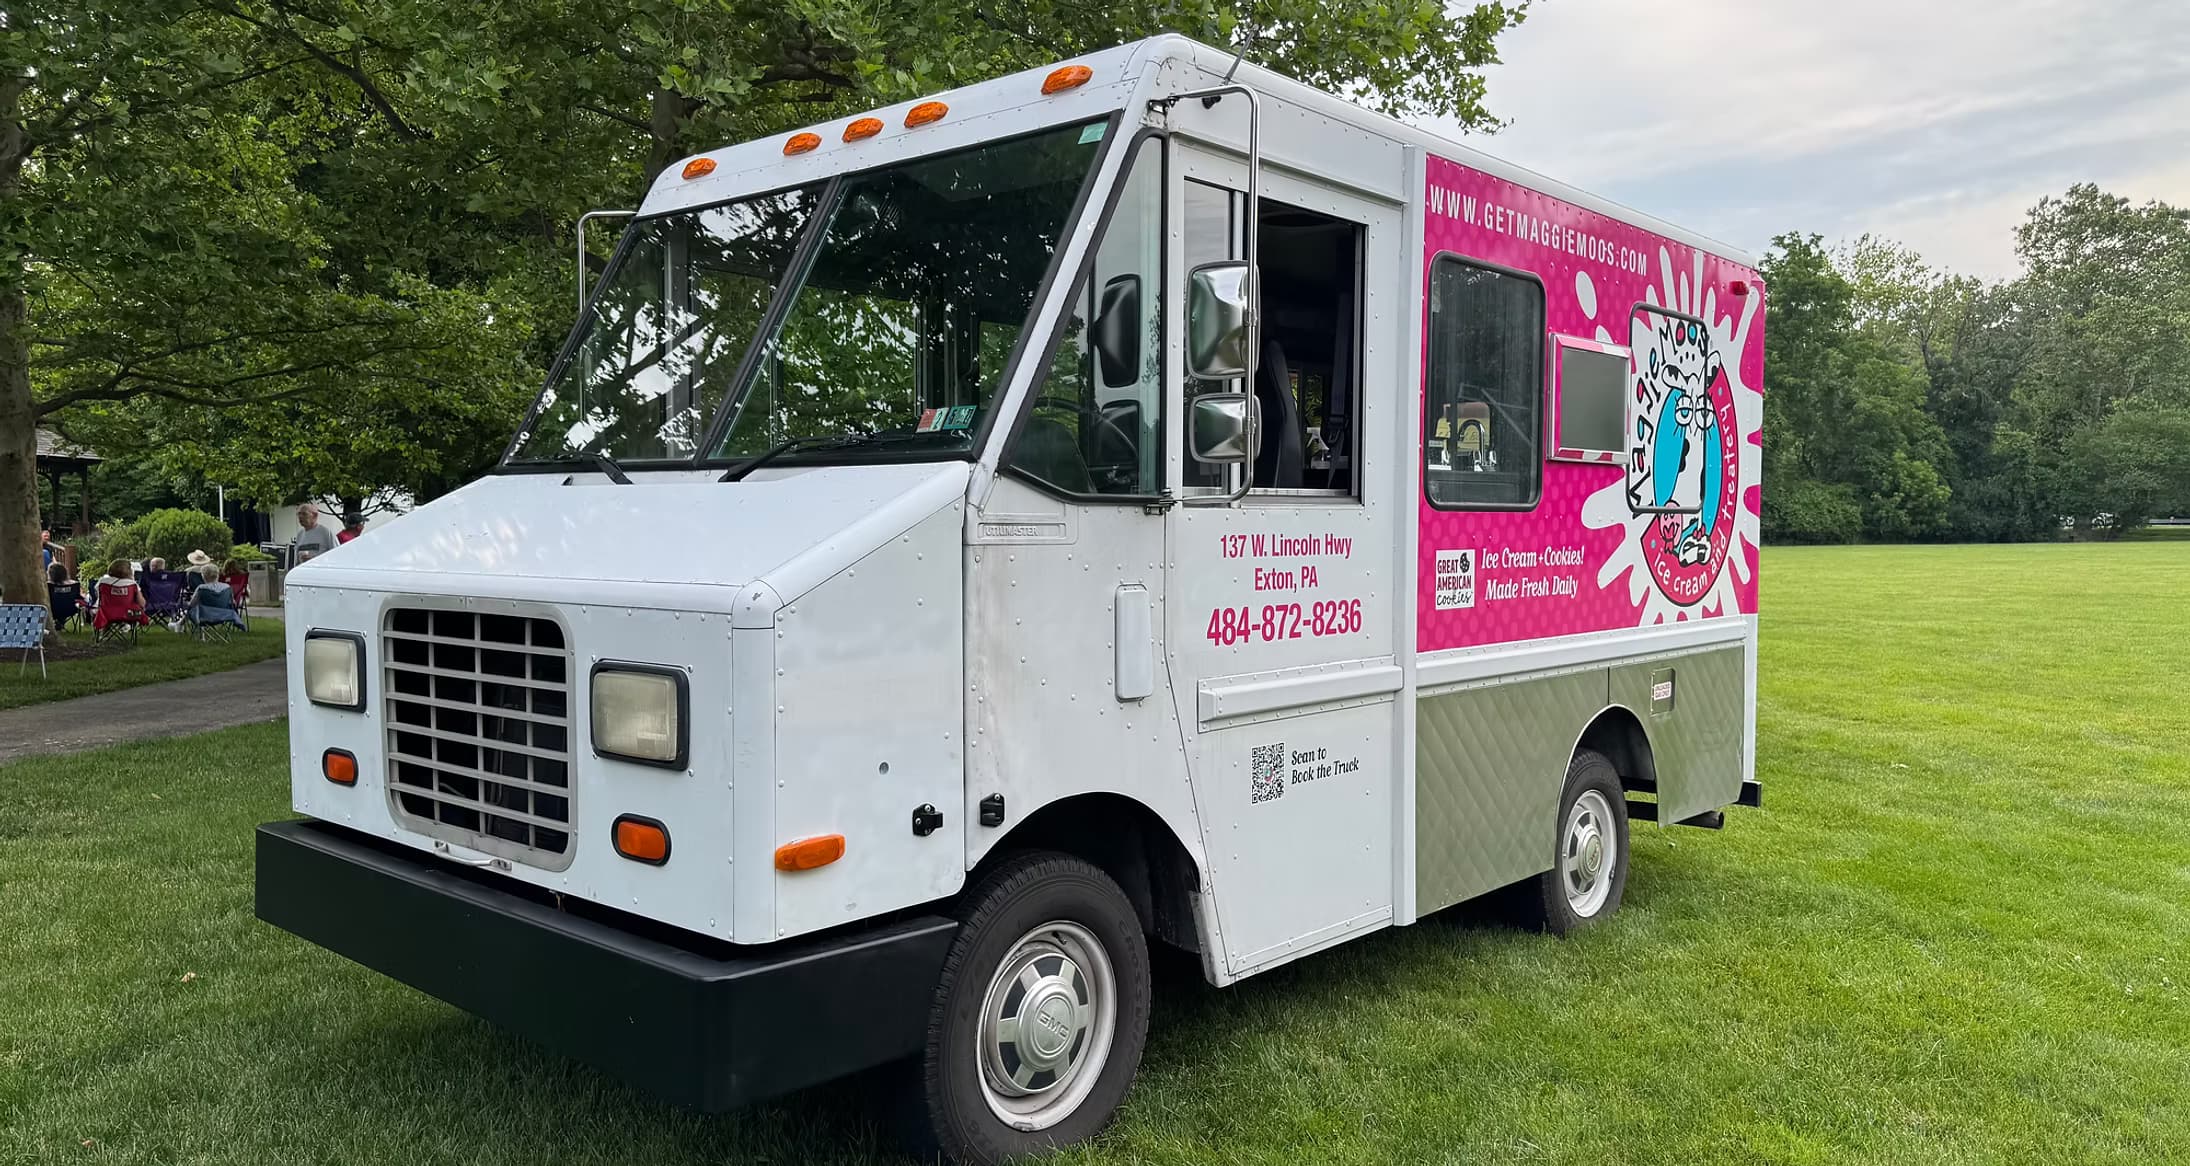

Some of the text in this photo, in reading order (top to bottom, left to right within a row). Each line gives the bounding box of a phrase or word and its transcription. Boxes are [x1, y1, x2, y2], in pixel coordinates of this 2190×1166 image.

[1430, 184, 1647, 276] WWW.GETMAGGIEMOOS.COM
[1654, 403, 1737, 597] ice cream and treatery
[1220, 533, 1352, 559] 137 W. Lincoln Hwy
[1481, 547, 1499, 569] Ice
[1255, 565, 1318, 593] Exton, PA
[1437, 559, 1459, 574] GREAT
[1437, 575, 1472, 591] AMERICAN
[1485, 574, 1579, 601] Made Fresh Daily
[1206, 598, 1363, 647] 484-872-8236
[1291, 747, 1327, 765] Scan to
[1291, 757, 1359, 785] Book the Truck
[1037, 1010, 1069, 1040] GMC
